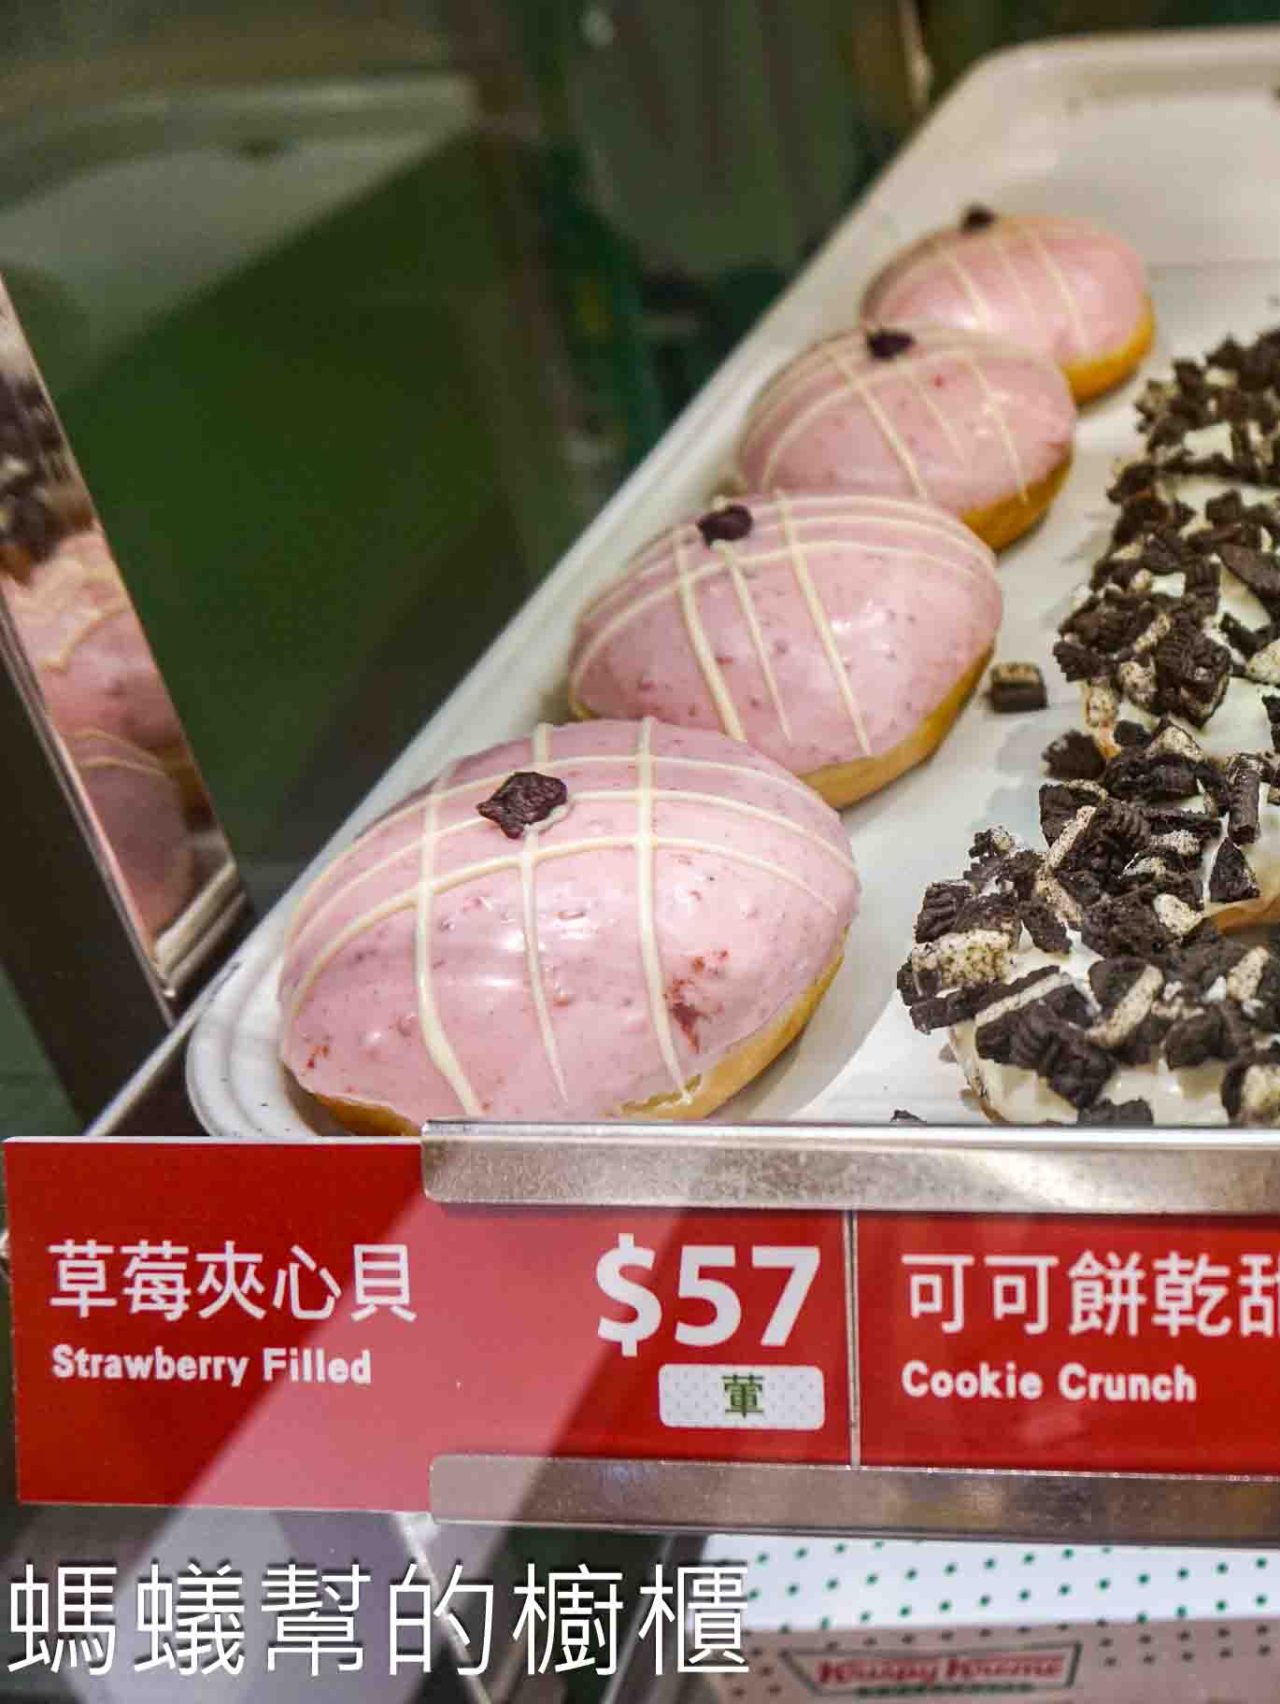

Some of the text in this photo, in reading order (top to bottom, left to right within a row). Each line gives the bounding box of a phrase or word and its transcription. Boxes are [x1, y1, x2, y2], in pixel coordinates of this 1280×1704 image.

[48, 1239, 418, 1323] 草莓夾心貝
[595, 1232, 822, 1358] $57
[52, 1343, 372, 1387] Strawberry Filled
[901, 1359, 1197, 1402] Cookie Crunch
[722, 1373, 764, 1419] 葷
